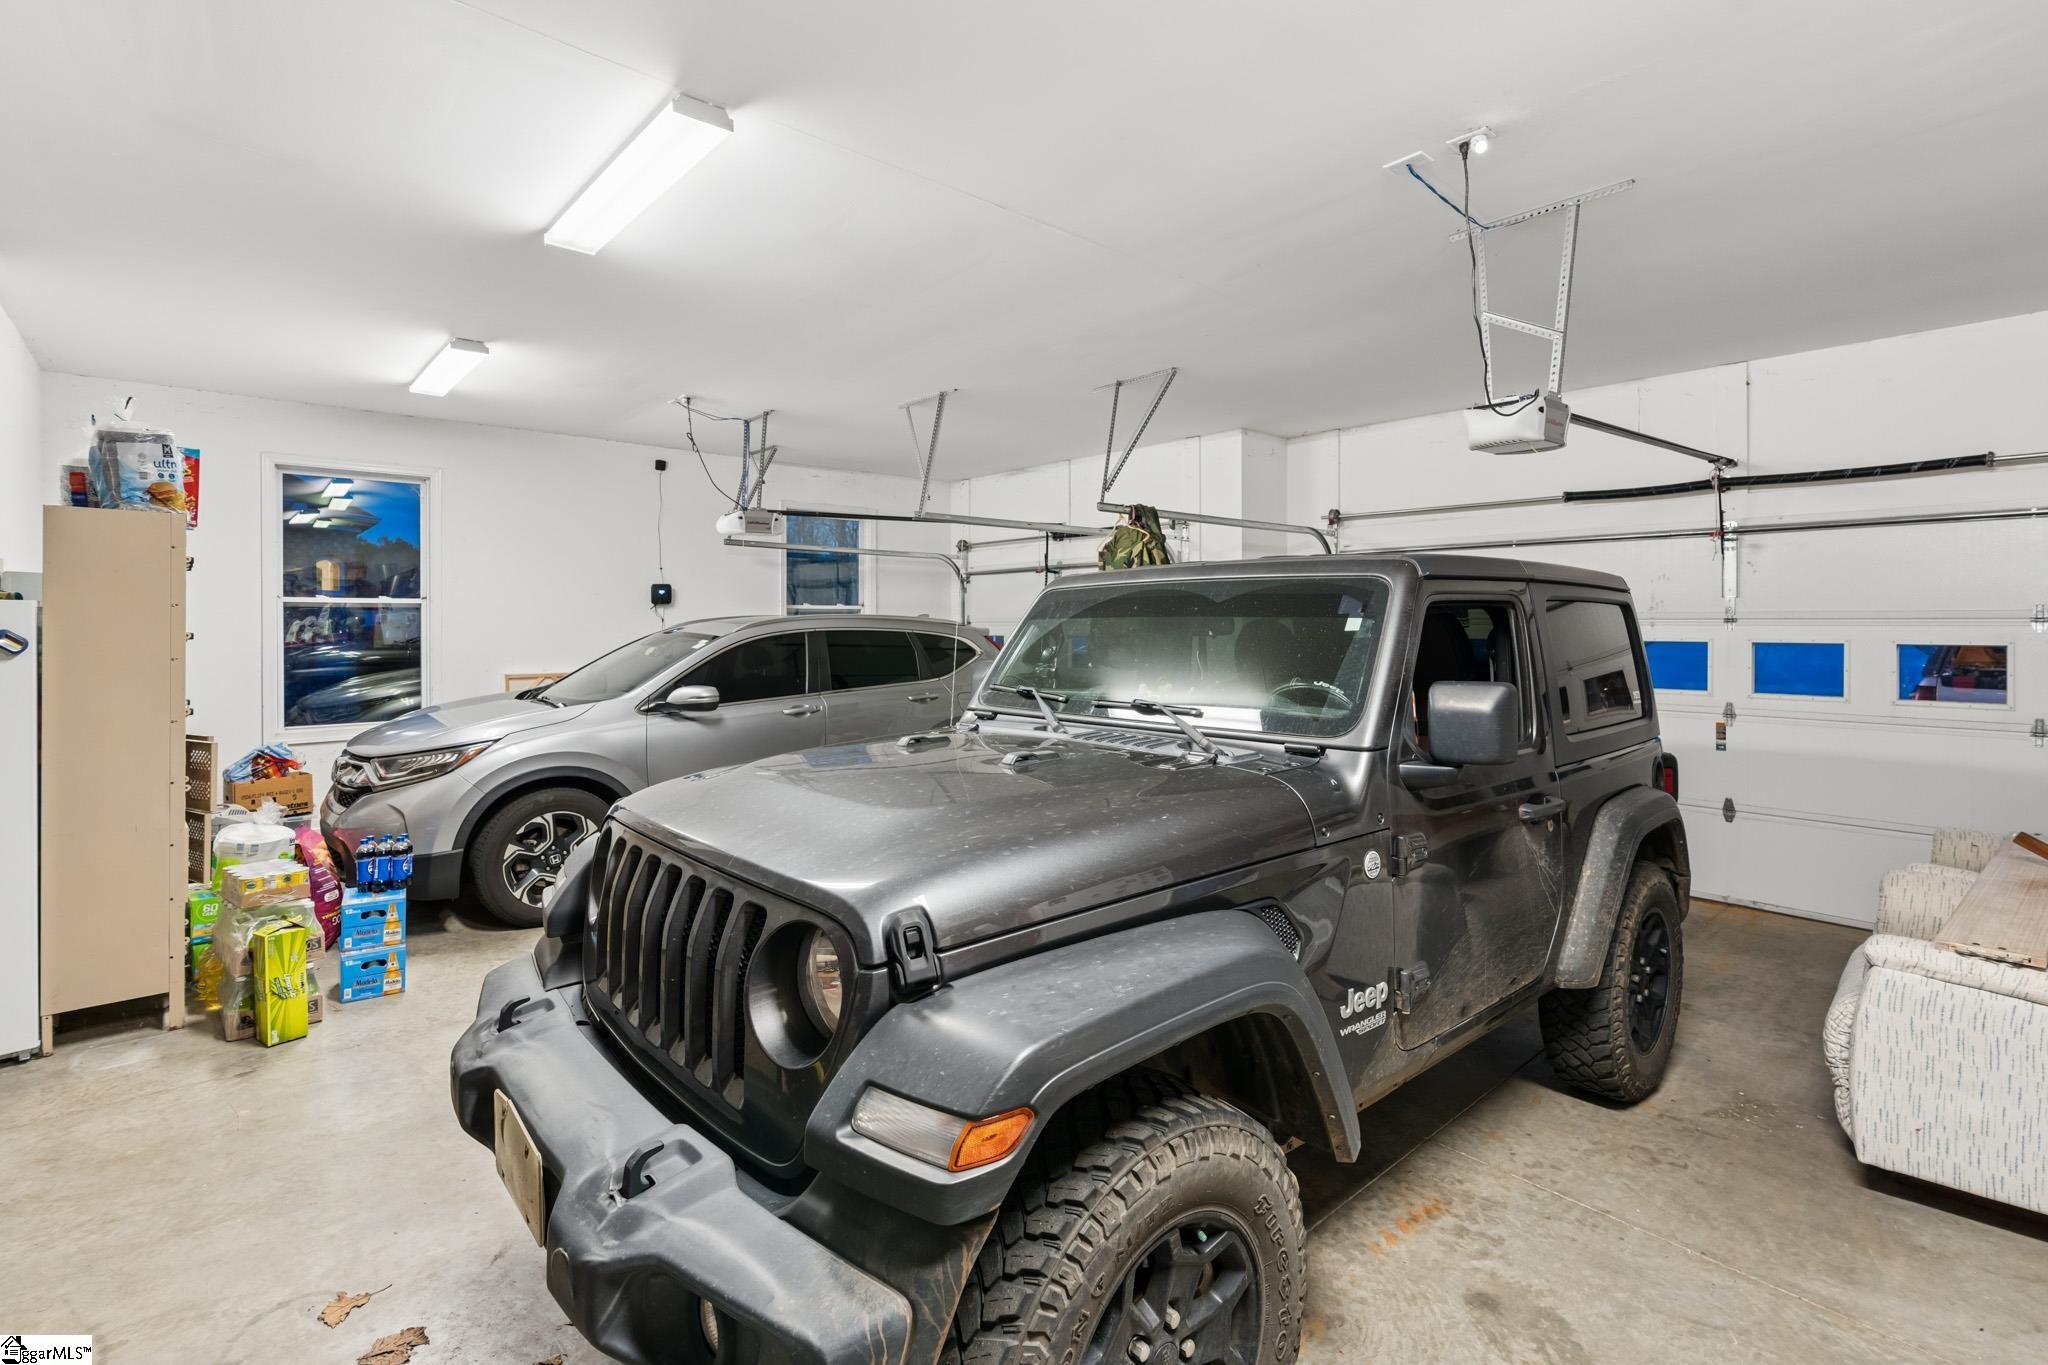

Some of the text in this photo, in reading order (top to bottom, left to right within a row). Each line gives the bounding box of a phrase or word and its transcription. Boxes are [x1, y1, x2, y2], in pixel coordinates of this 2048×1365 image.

[153, 459, 177, 469] ultr
[1340, 981, 1388, 1019] Jeep
[1340, 1010, 1387, 1037] WRANGLER
